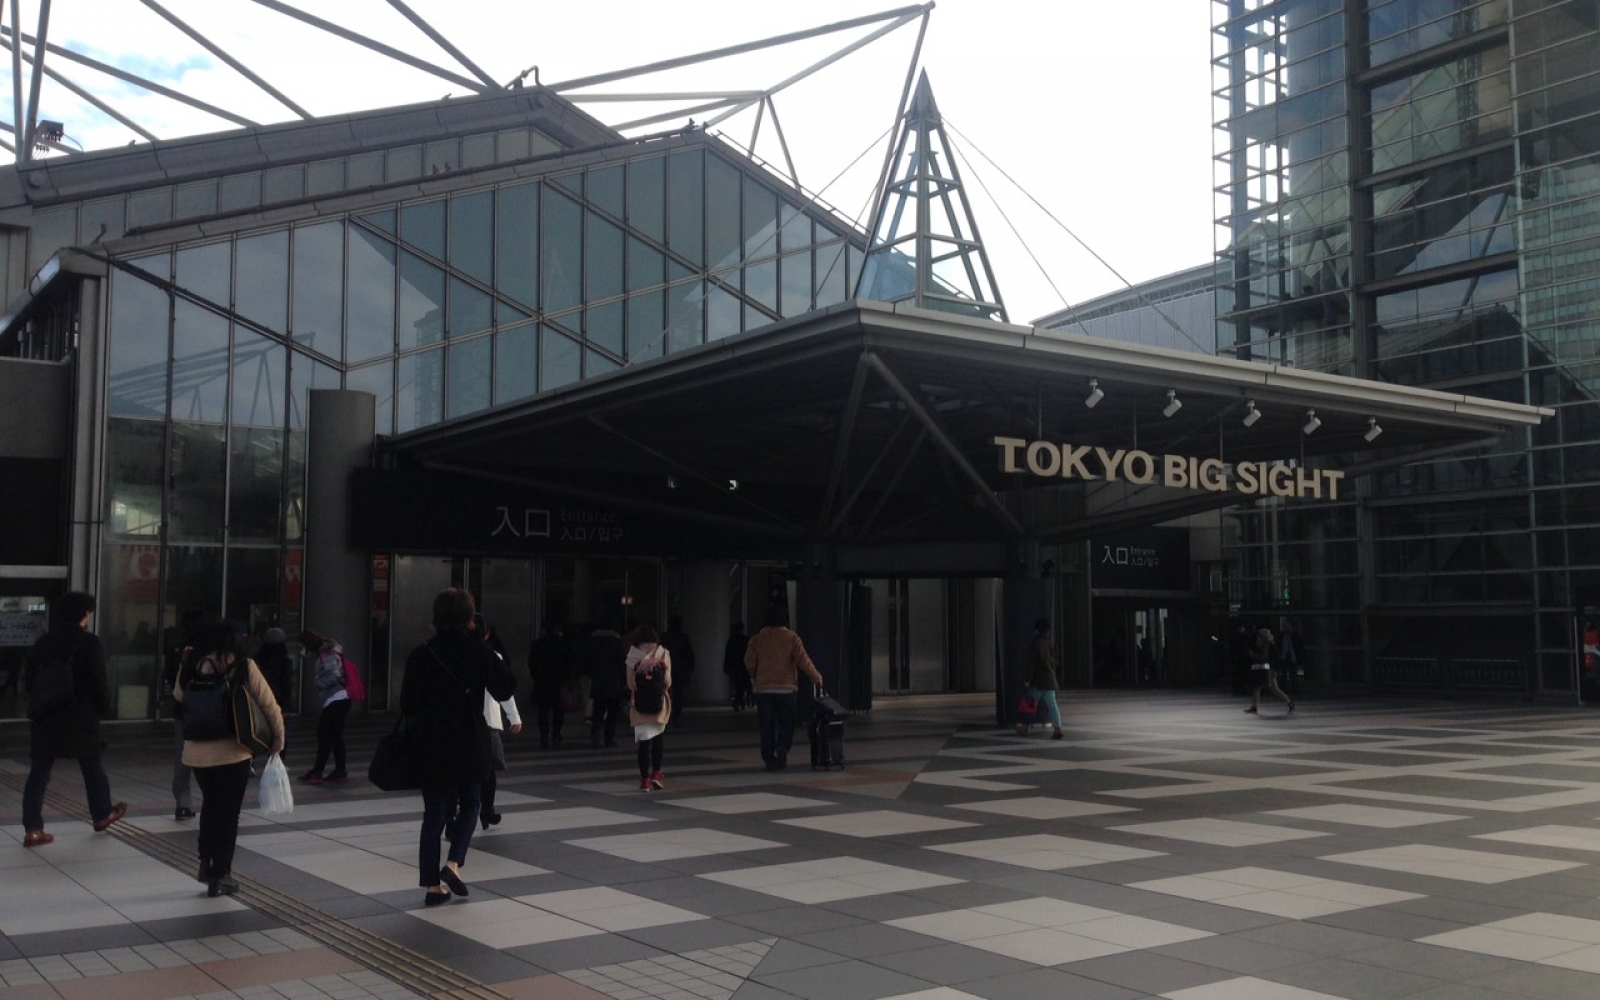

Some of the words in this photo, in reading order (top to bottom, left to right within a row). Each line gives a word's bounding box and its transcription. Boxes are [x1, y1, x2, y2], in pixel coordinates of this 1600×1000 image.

[994, 435, 1155, 485] TOKYO
[1164, 454, 1228, 492] BIG
[1236, 461, 1345, 501] SIGHT
[491, 506, 551, 538] 入口
[1101, 545, 1128, 565] 入口
